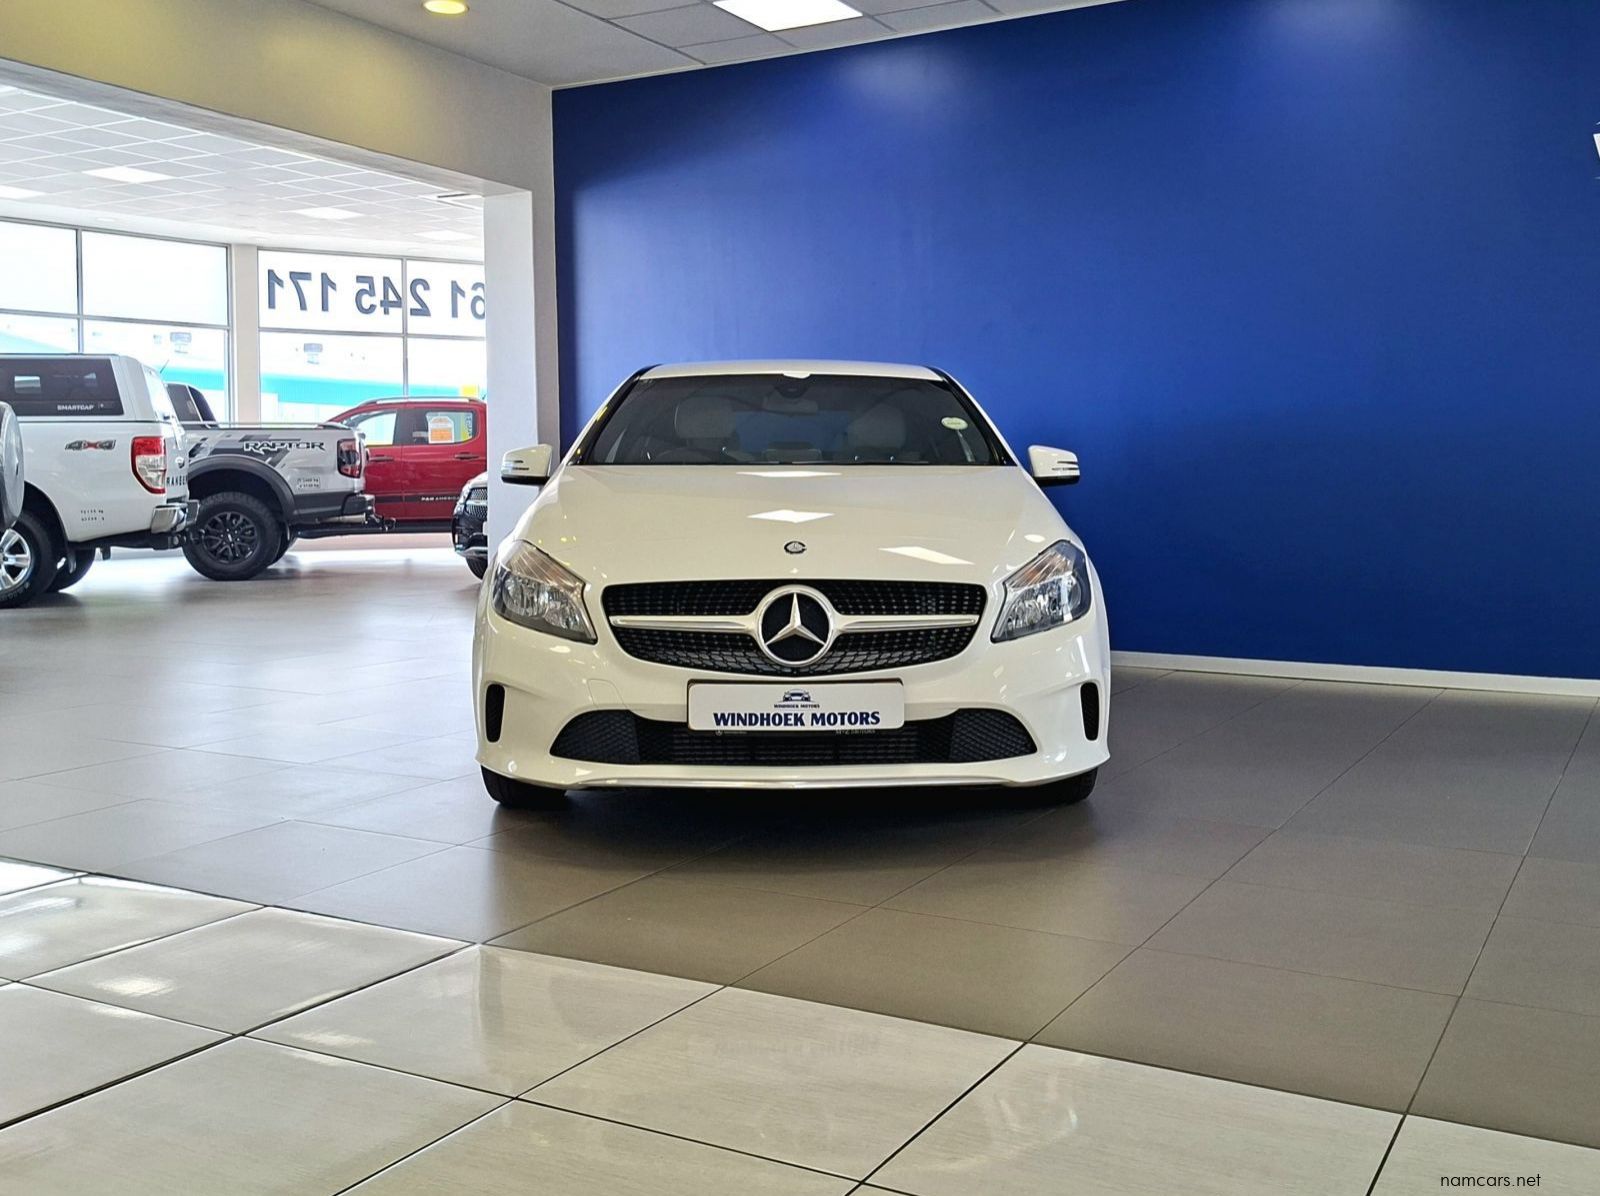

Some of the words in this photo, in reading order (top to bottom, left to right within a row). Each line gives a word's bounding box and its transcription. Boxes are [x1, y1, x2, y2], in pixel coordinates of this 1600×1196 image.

[243, 440, 326, 455] RAPTOR
[713, 712, 805, 727] WINDHOEK
[811, 711, 880, 726] MOTORS
